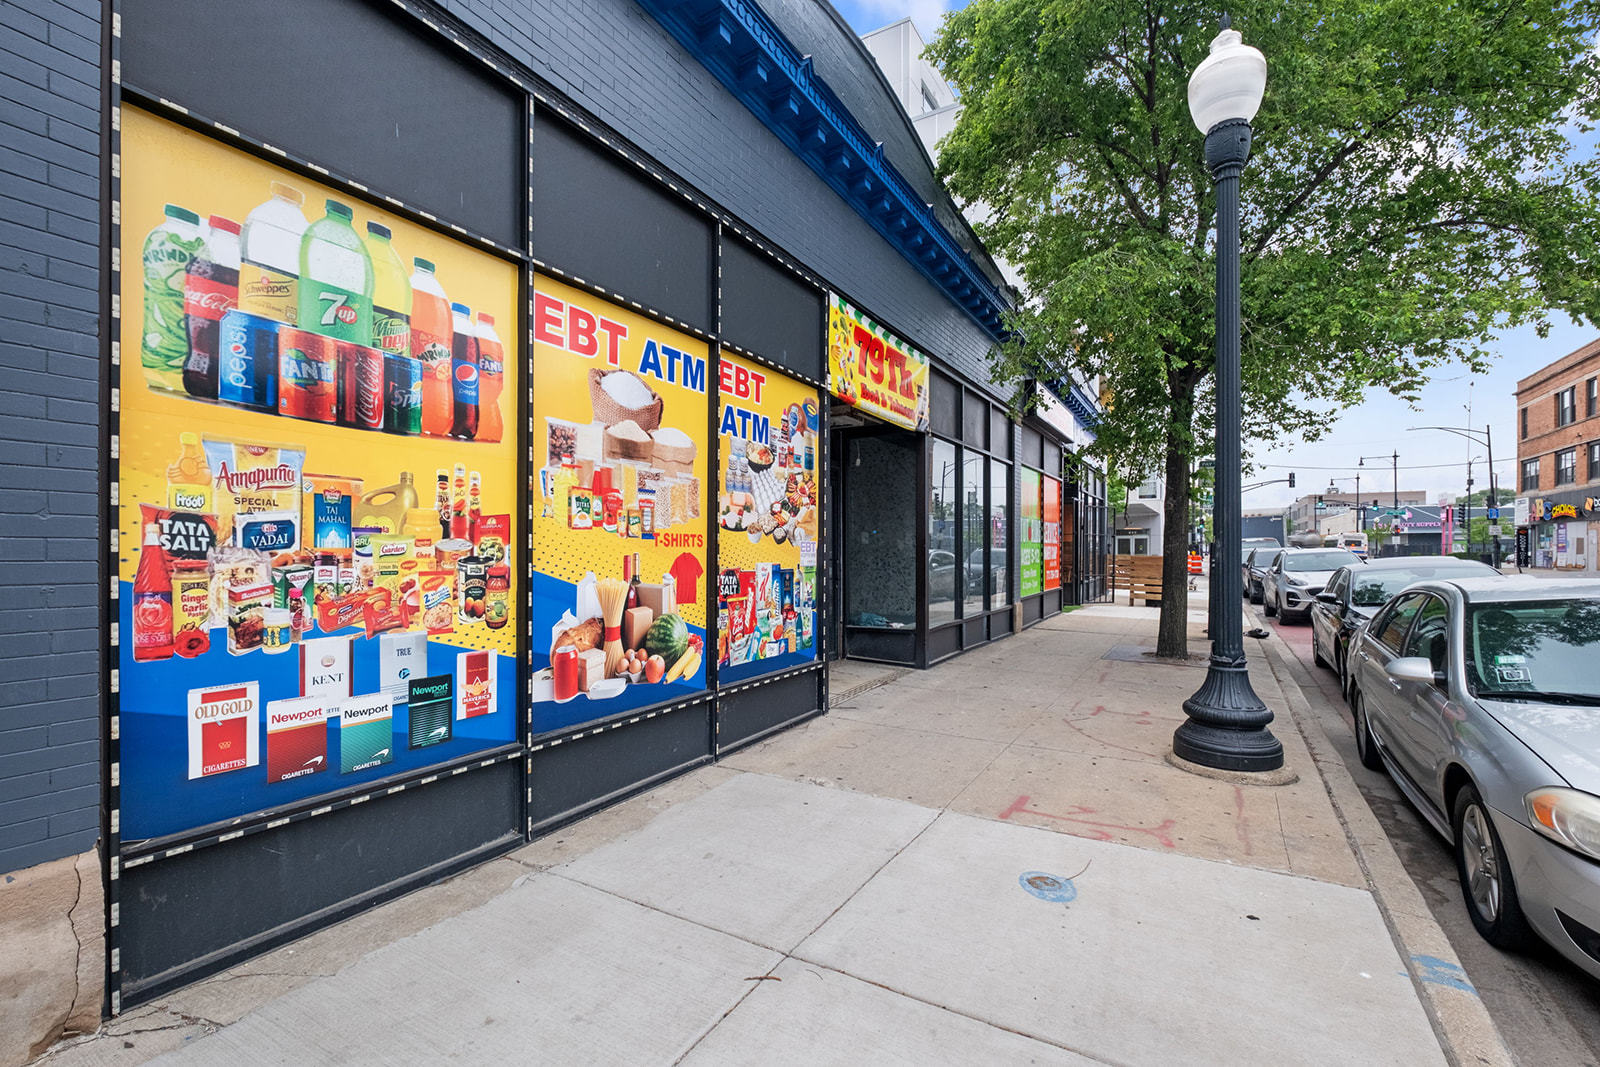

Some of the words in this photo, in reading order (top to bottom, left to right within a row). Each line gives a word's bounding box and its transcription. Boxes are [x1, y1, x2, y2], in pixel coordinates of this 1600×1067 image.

[534, 291, 628, 366] EBT
[637, 338, 706, 393] ATM
[229, 326, 253, 389] pepsi
[720, 359, 765, 404] EBT
[720, 405, 769, 446] ATM
[215, 461, 295, 494] Annapurna
[234, 497, 279, 507] SPECIAL
[326, 506, 338, 515] TAJ
[1529, 498, 1553, 521] ABC
[1552, 503, 1576, 518] CHOICE
[318, 514, 347, 524] MAHAL
[159, 519, 209, 537] TATA
[159, 534, 210, 550] SALT
[250, 533, 288, 547] VADAI
[654, 533, 704, 547] T-SHIRTS
[801, 541, 816, 552] EBT
[721, 576, 738, 585] TATA
[720, 585, 738, 595] SALT
[396, 648, 412, 657] TRUE
[313, 673, 344, 686] KENT
[412, 682, 448, 696] Newport
[195, 705, 219, 720] OLD
[221, 699, 253, 716] GOLD
[271, 707, 322, 724] Newport
[344, 704, 389, 719] Newport
[203, 758, 246, 774] CIGARETTES
[353, 760, 381, 772] CIGARETTES
[281, 768, 314, 781] CIGARETTES
